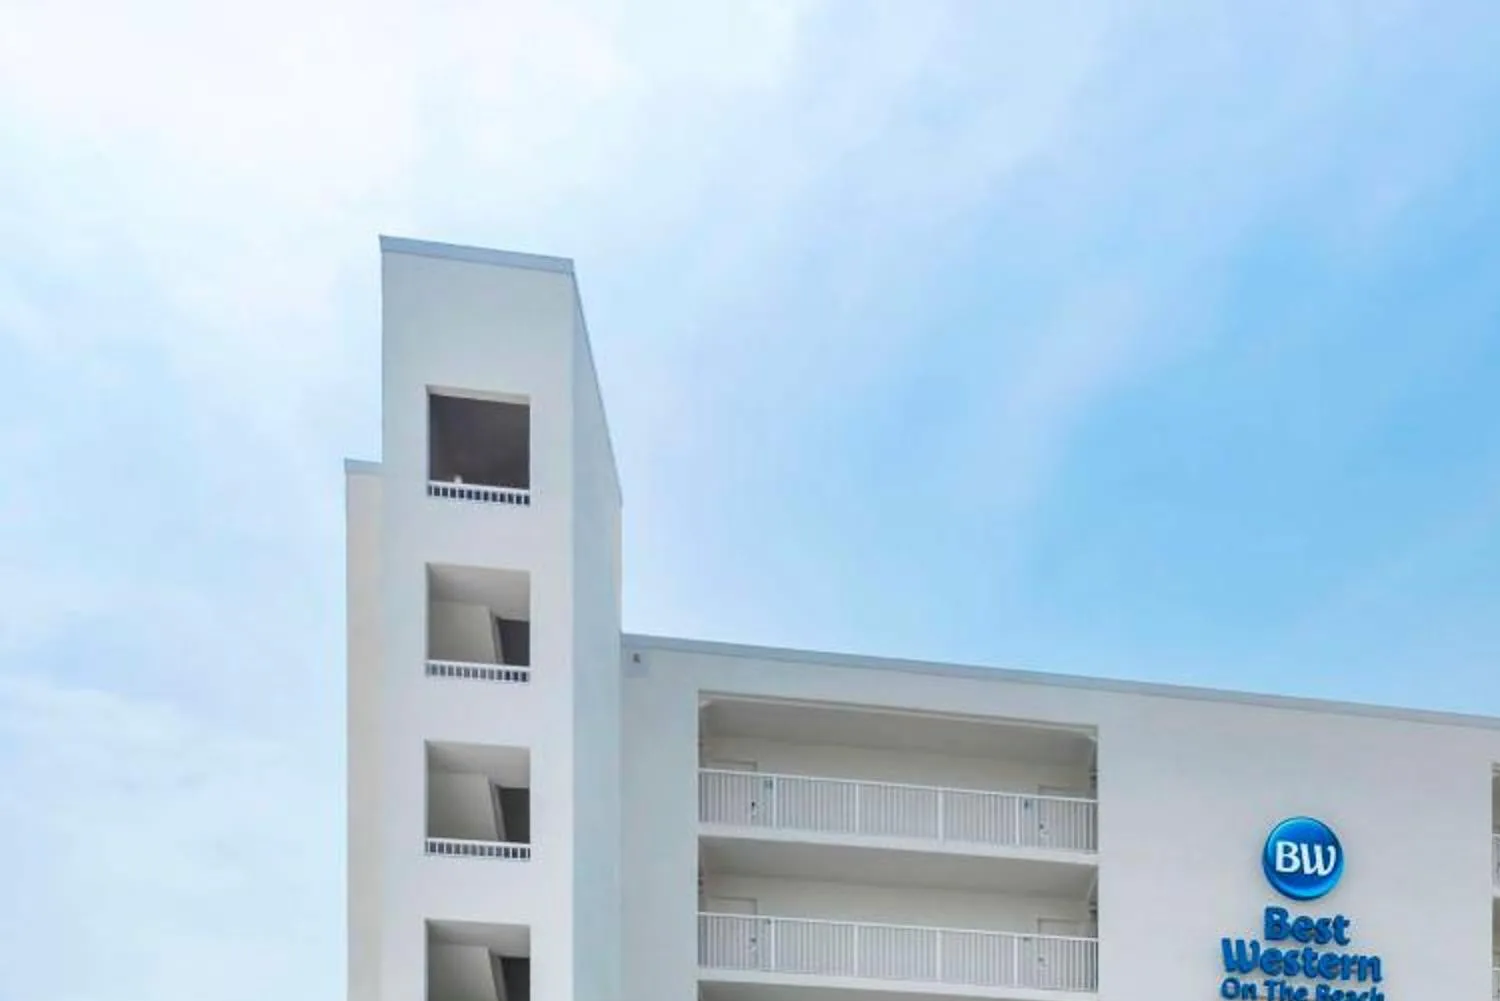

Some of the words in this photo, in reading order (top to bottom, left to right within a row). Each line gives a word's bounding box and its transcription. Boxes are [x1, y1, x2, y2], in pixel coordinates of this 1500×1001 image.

[1275, 840, 1337, 876] BW
[1264, 906, 1350, 946] Best
[1221, 937, 1382, 982] Western
[1221, 977, 1257, 1001] On
